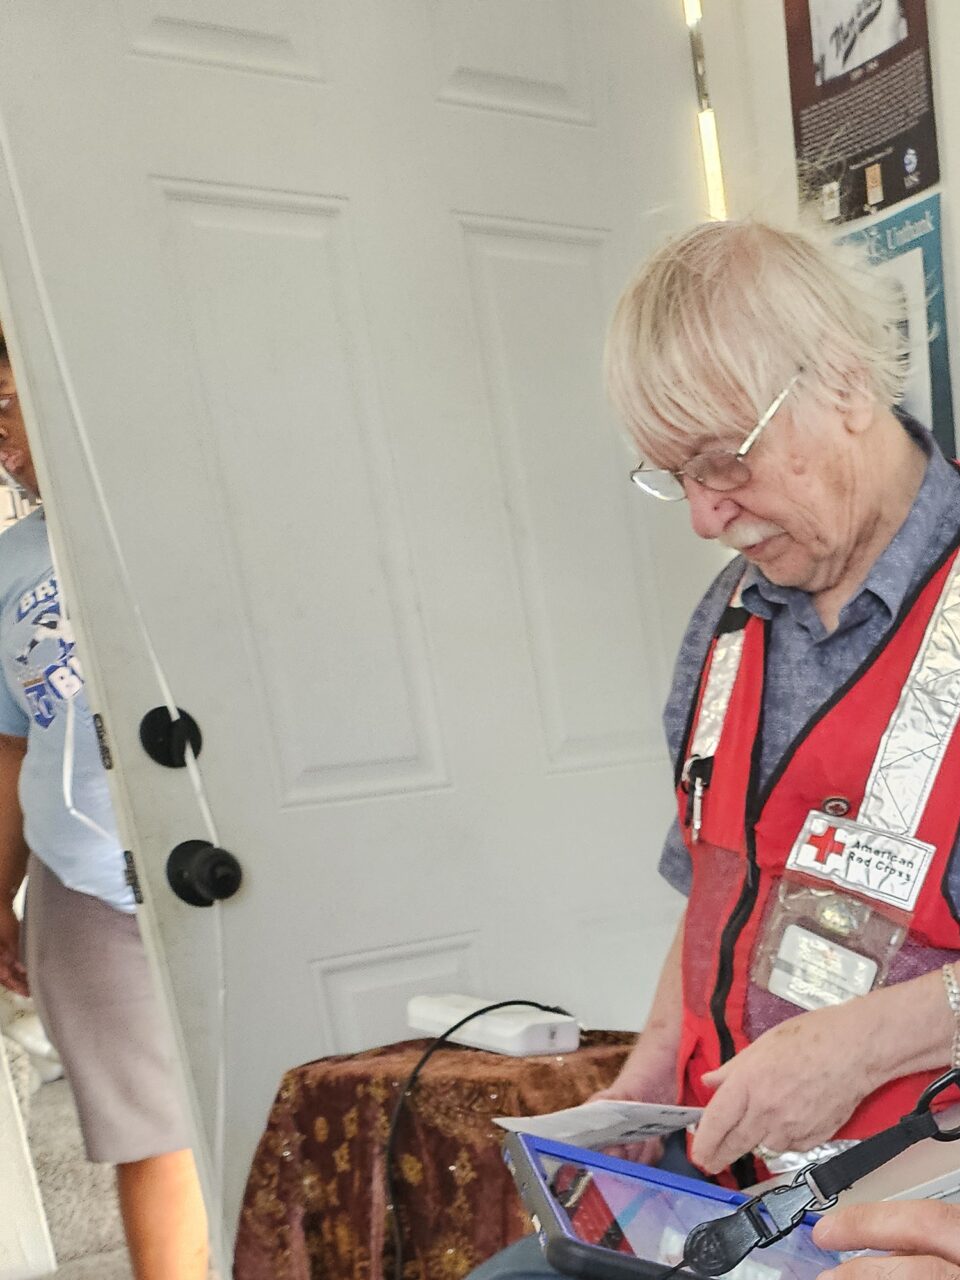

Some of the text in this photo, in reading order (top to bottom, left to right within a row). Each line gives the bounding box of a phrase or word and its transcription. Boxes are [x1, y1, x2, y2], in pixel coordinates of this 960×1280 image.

[847, 851, 912, 882] Red Cross
[851, 840, 915, 868] American
